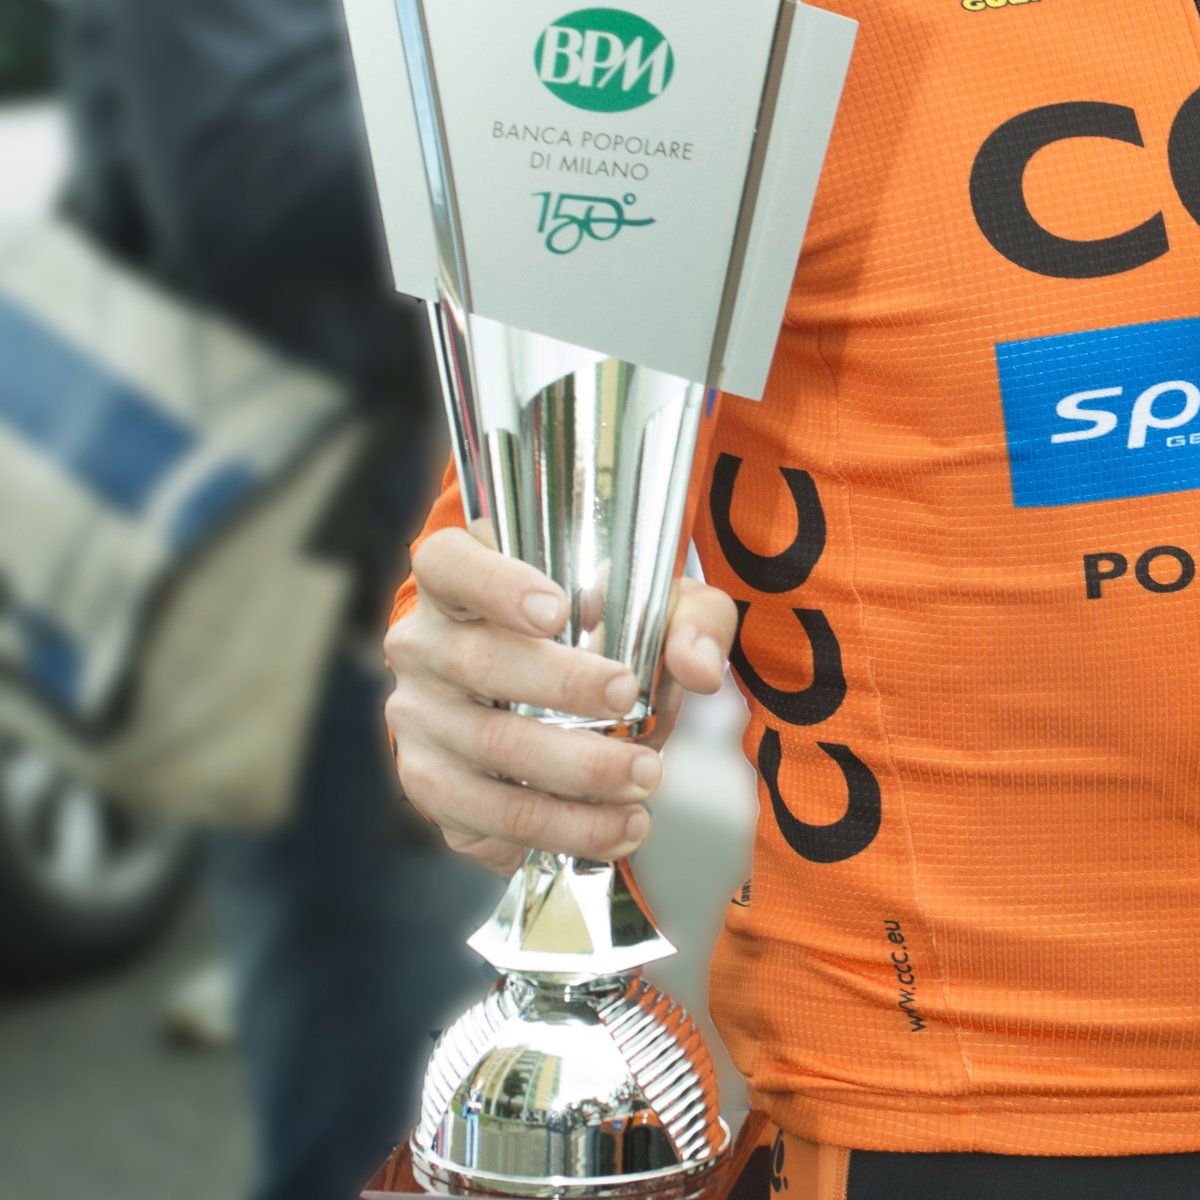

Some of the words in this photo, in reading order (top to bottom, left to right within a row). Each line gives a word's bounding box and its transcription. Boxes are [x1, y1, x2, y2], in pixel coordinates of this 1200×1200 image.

[538, 25, 670, 96] BPM
[492, 121, 572, 147] BANCA
[582, 131, 694, 160] POPOLARE
[530, 152, 551, 169] DI
[560, 156, 649, 181] MILANO
[709, 452, 882, 864] CCC
